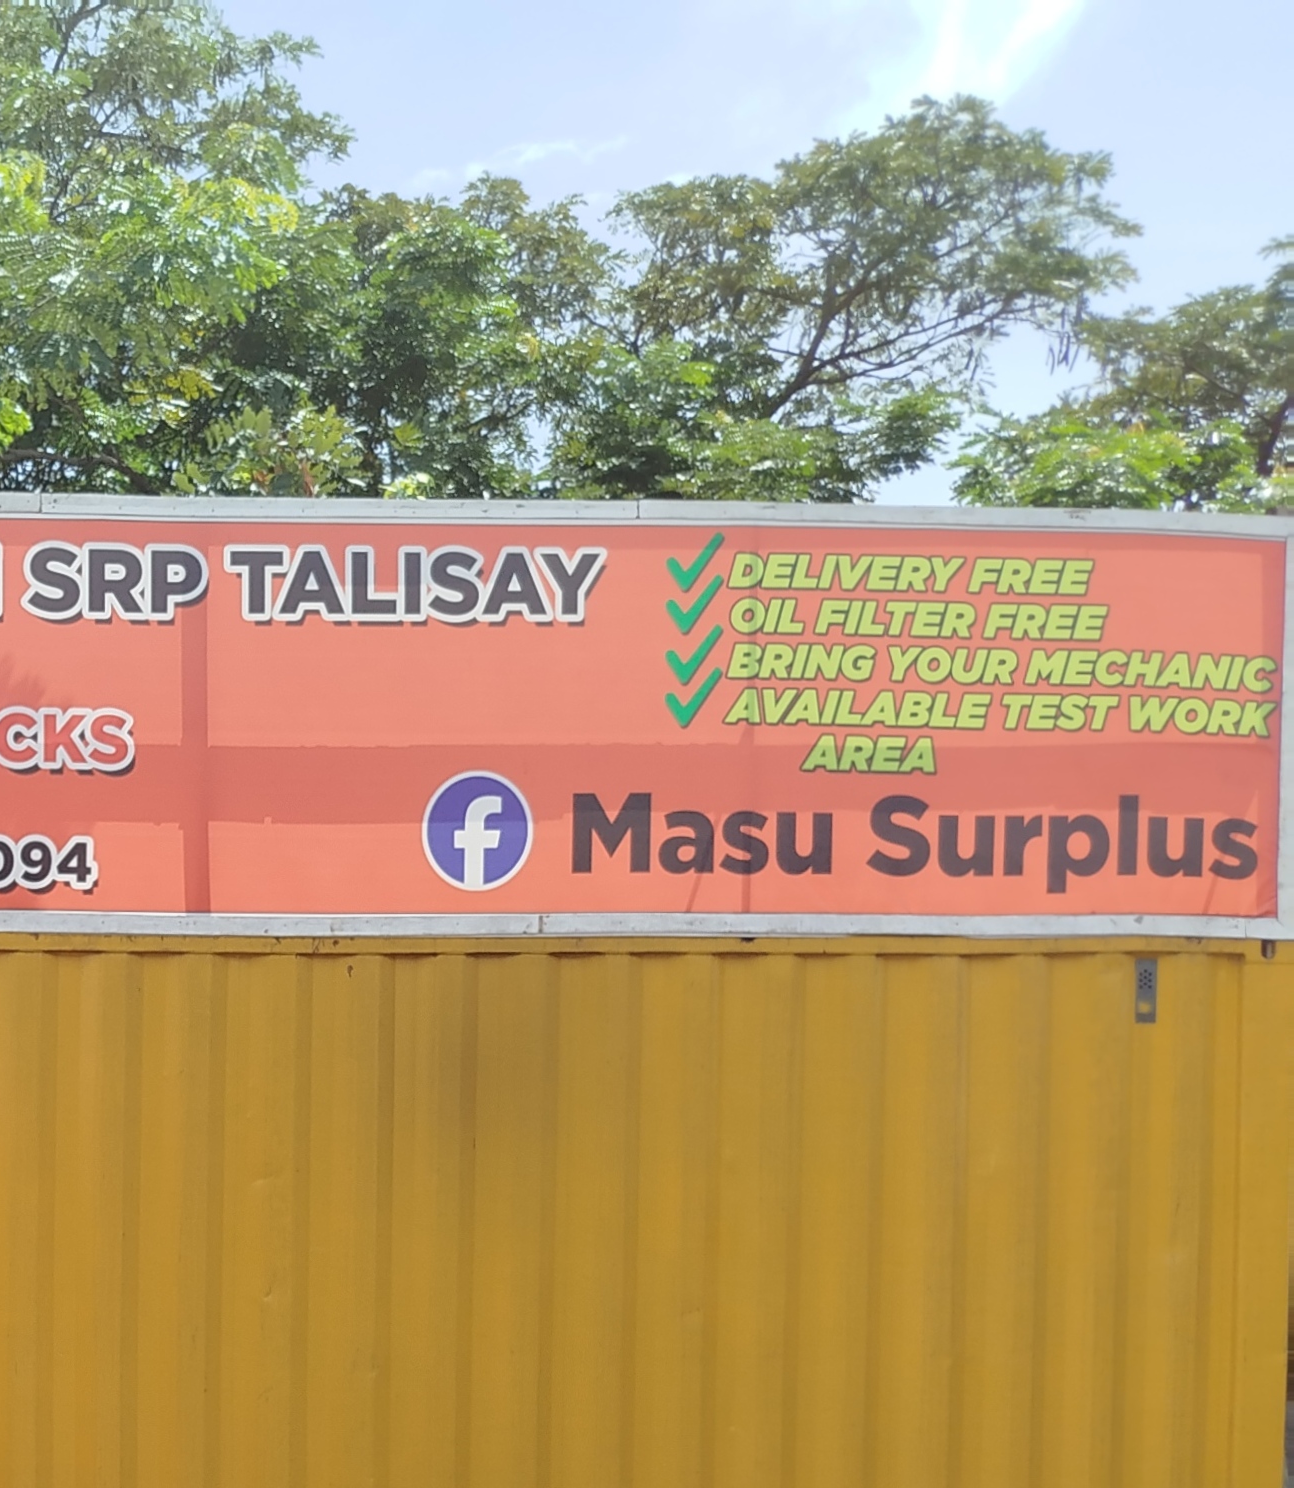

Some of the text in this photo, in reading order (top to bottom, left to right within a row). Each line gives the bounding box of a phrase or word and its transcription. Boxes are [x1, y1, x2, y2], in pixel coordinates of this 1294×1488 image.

[26, 544, 204, 618] SRP
[228, 545, 603, 619] TALISAY
[727, 553, 1094, 596] DELIVERY FREE
[730, 598, 1108, 641] OIL FILTER FREE
[726, 644, 1277, 694] BRING YOUR MECHANIC
[724, 689, 1277, 737] AVAILABLE TEST WORK
[800, 734, 937, 774] AREA
[571, 792, 1258, 894] Masu Surplus
